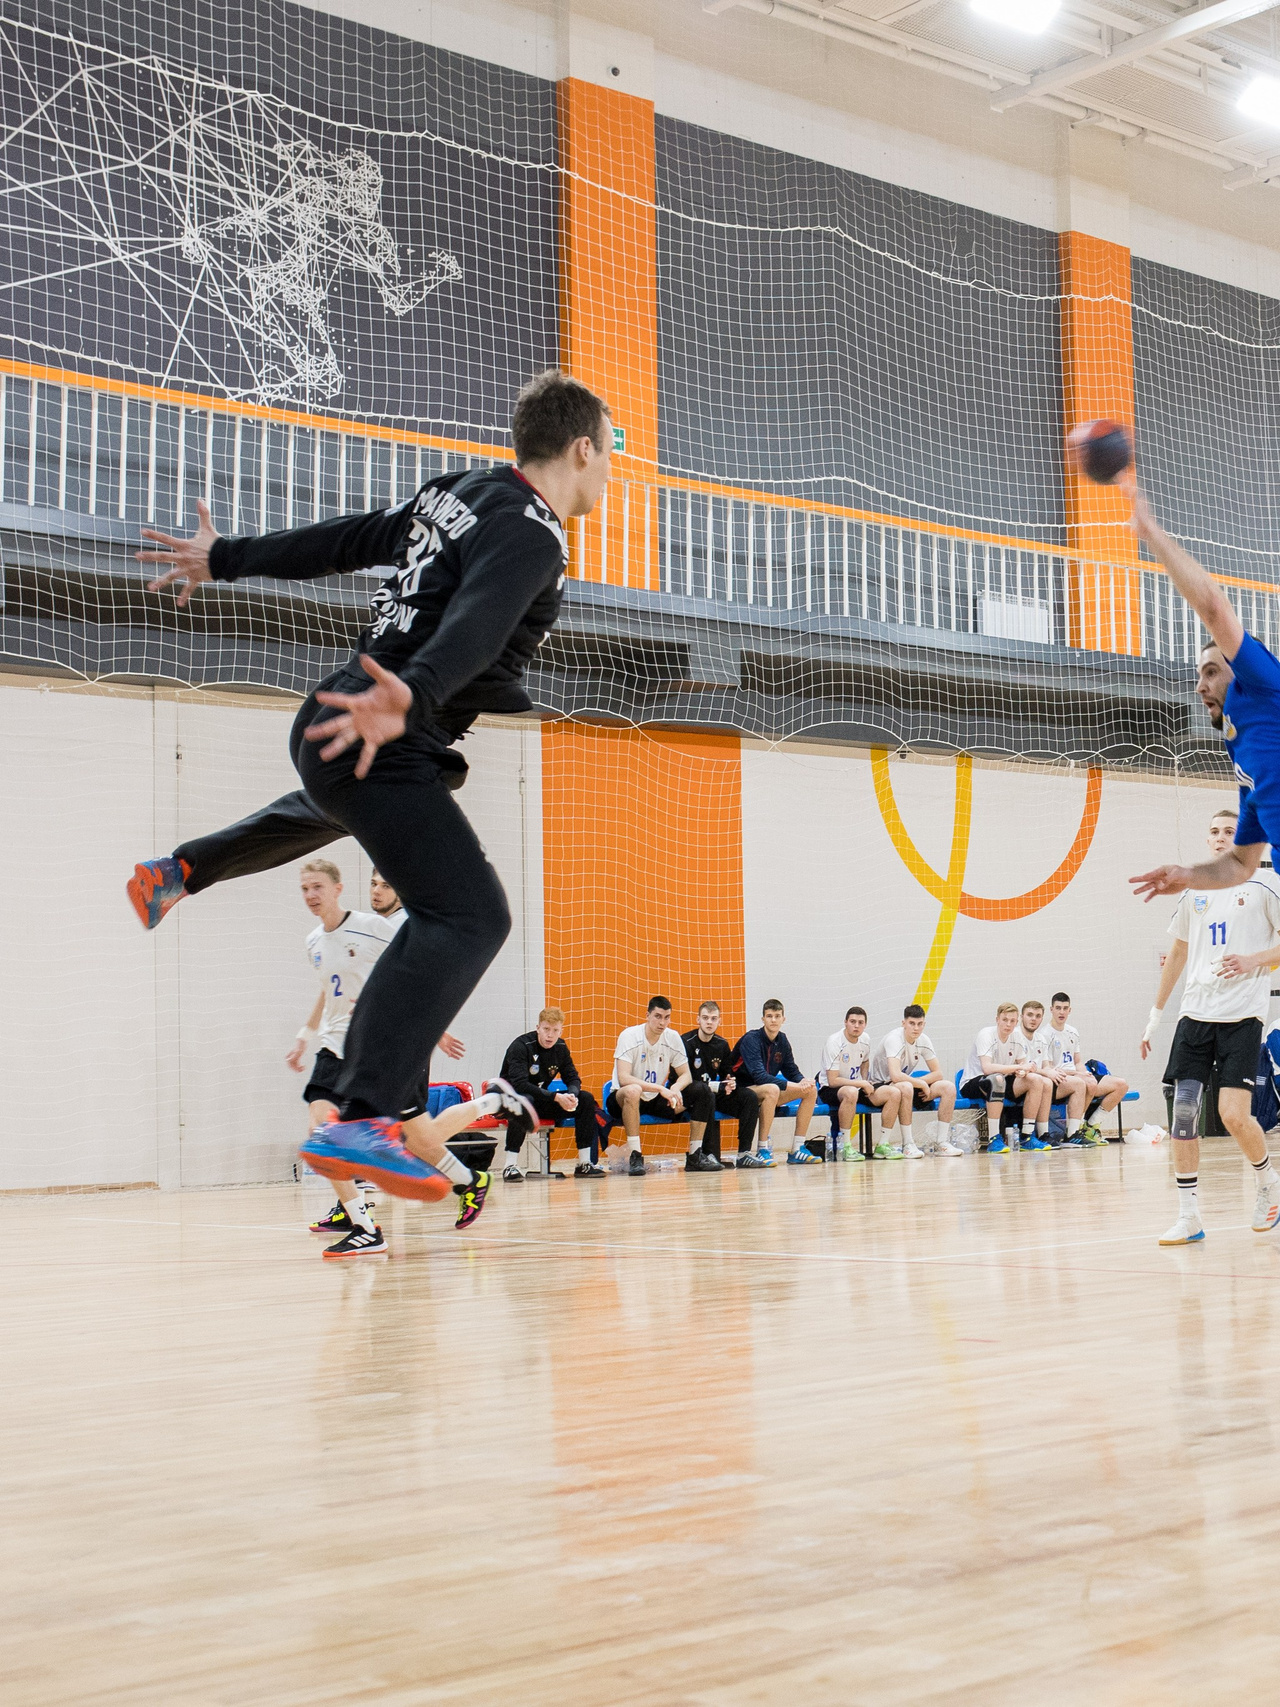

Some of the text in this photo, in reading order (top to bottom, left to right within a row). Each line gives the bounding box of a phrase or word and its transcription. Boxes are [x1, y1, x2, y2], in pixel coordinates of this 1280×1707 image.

[1209, 921, 1226, 946] 11
[331, 974, 343, 997] 2
[644, 1070, 657, 1084] 20
